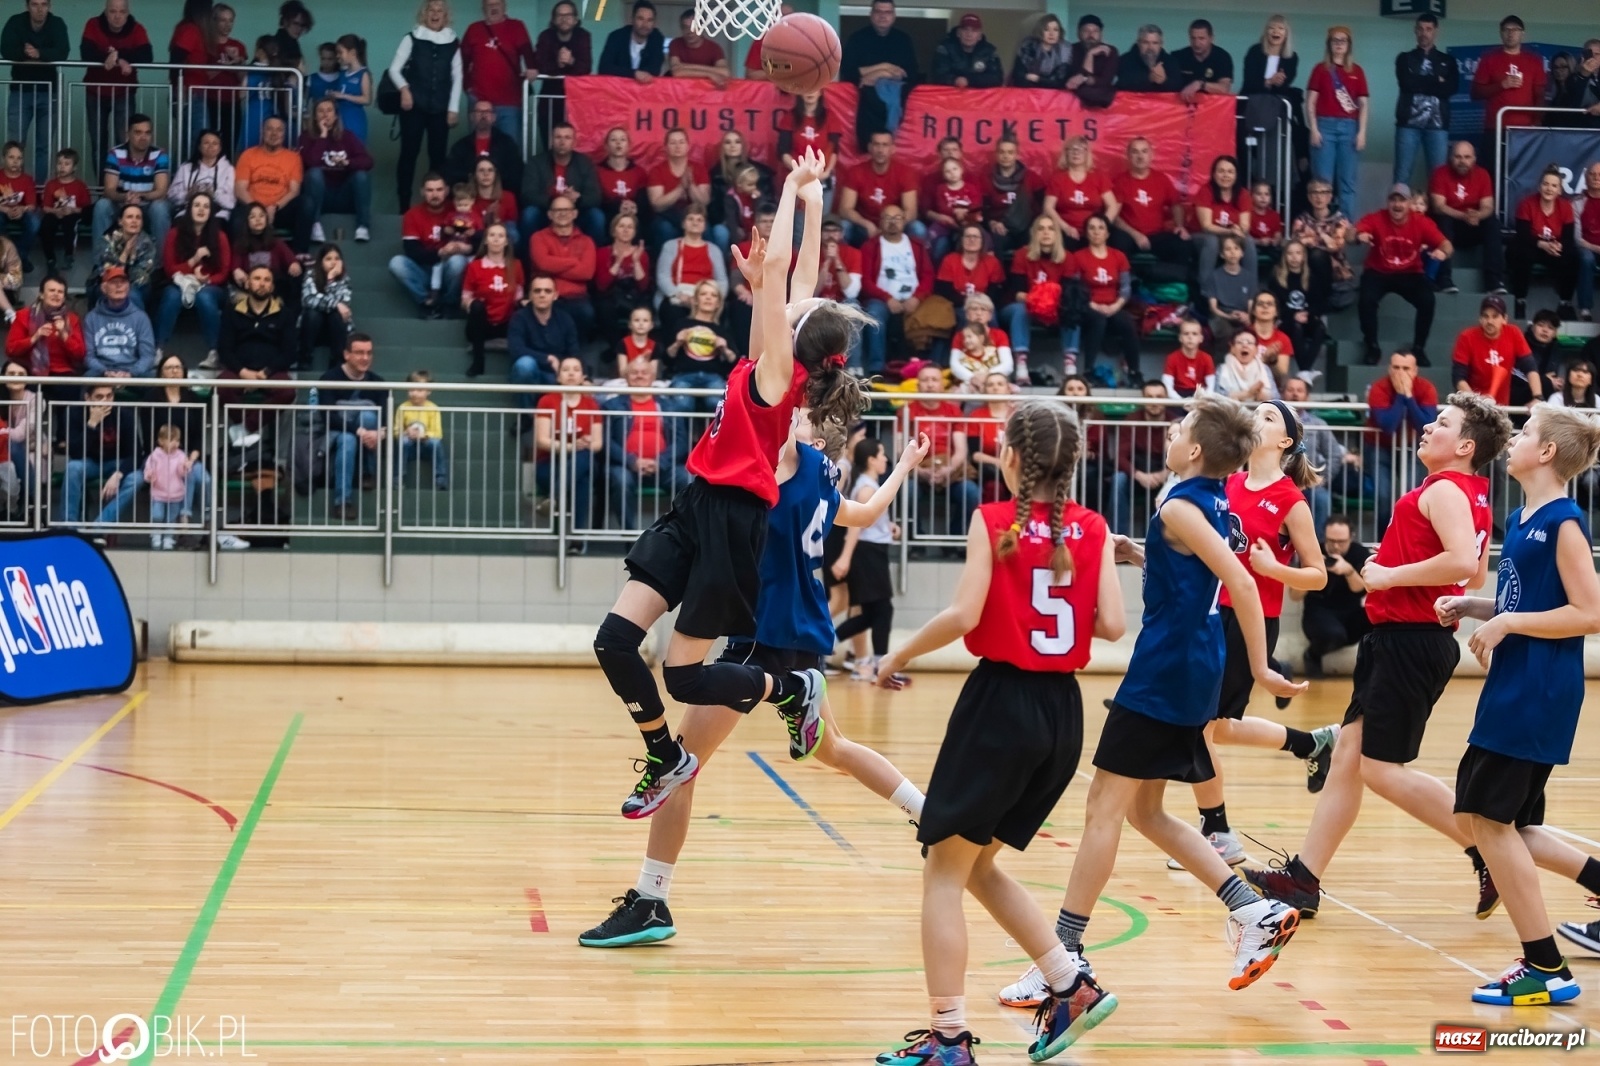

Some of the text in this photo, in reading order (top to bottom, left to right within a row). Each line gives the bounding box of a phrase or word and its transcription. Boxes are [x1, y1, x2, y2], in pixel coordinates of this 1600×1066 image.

[635, 108, 1098, 145] HOUSTO ROCKETS
[35, 565, 103, 650] nba
[1030, 567, 1076, 656] 5
